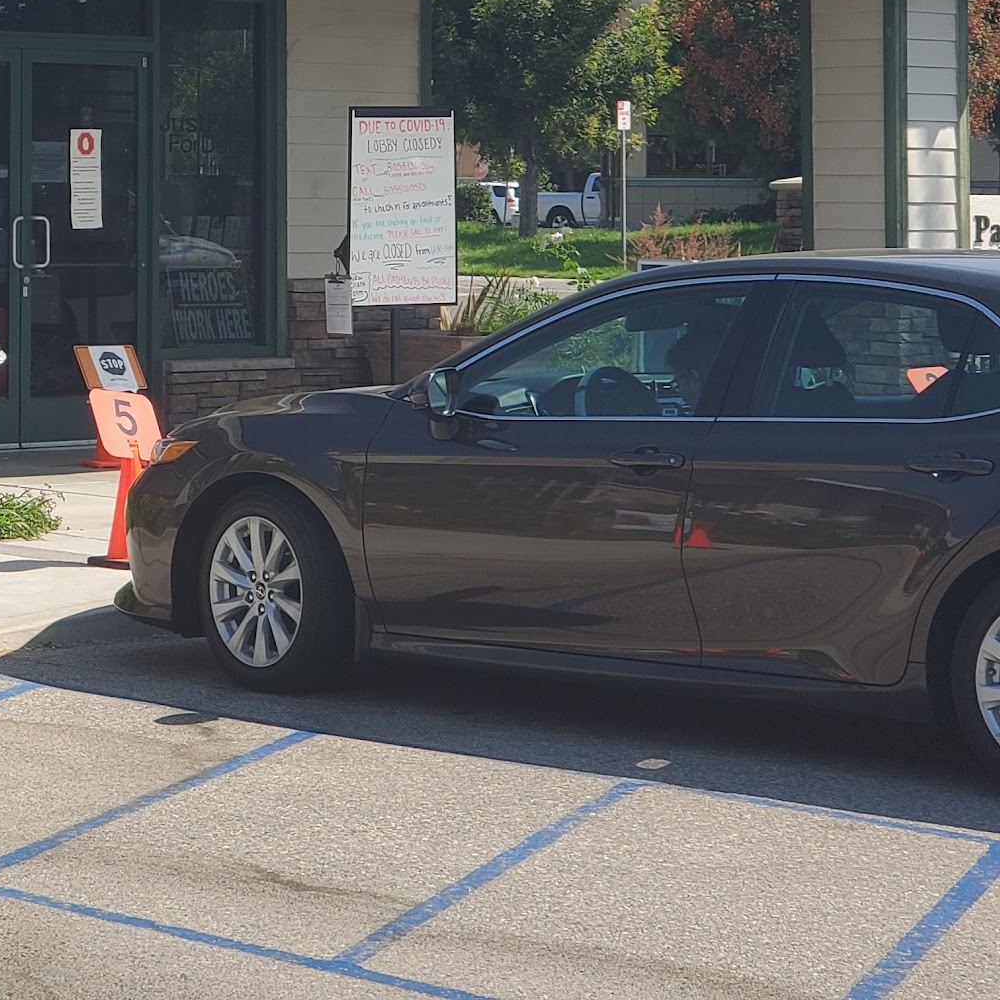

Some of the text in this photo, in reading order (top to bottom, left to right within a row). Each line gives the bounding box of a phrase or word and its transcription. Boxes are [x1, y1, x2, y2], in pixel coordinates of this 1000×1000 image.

[358, 120, 381, 136] DUE
[384, 121, 396, 130] TO
[367, 138, 398, 153] LOBBY
[353, 163, 377, 175] TEXT
[352, 186, 374, 197] CALL
[382, 243, 412, 259] CLOSED
[179, 272, 238, 301] HEROES
[175, 309, 252, 340] WORK HERE
[100, 359, 125, 370] STOP
[113, 399, 138, 436] 5
